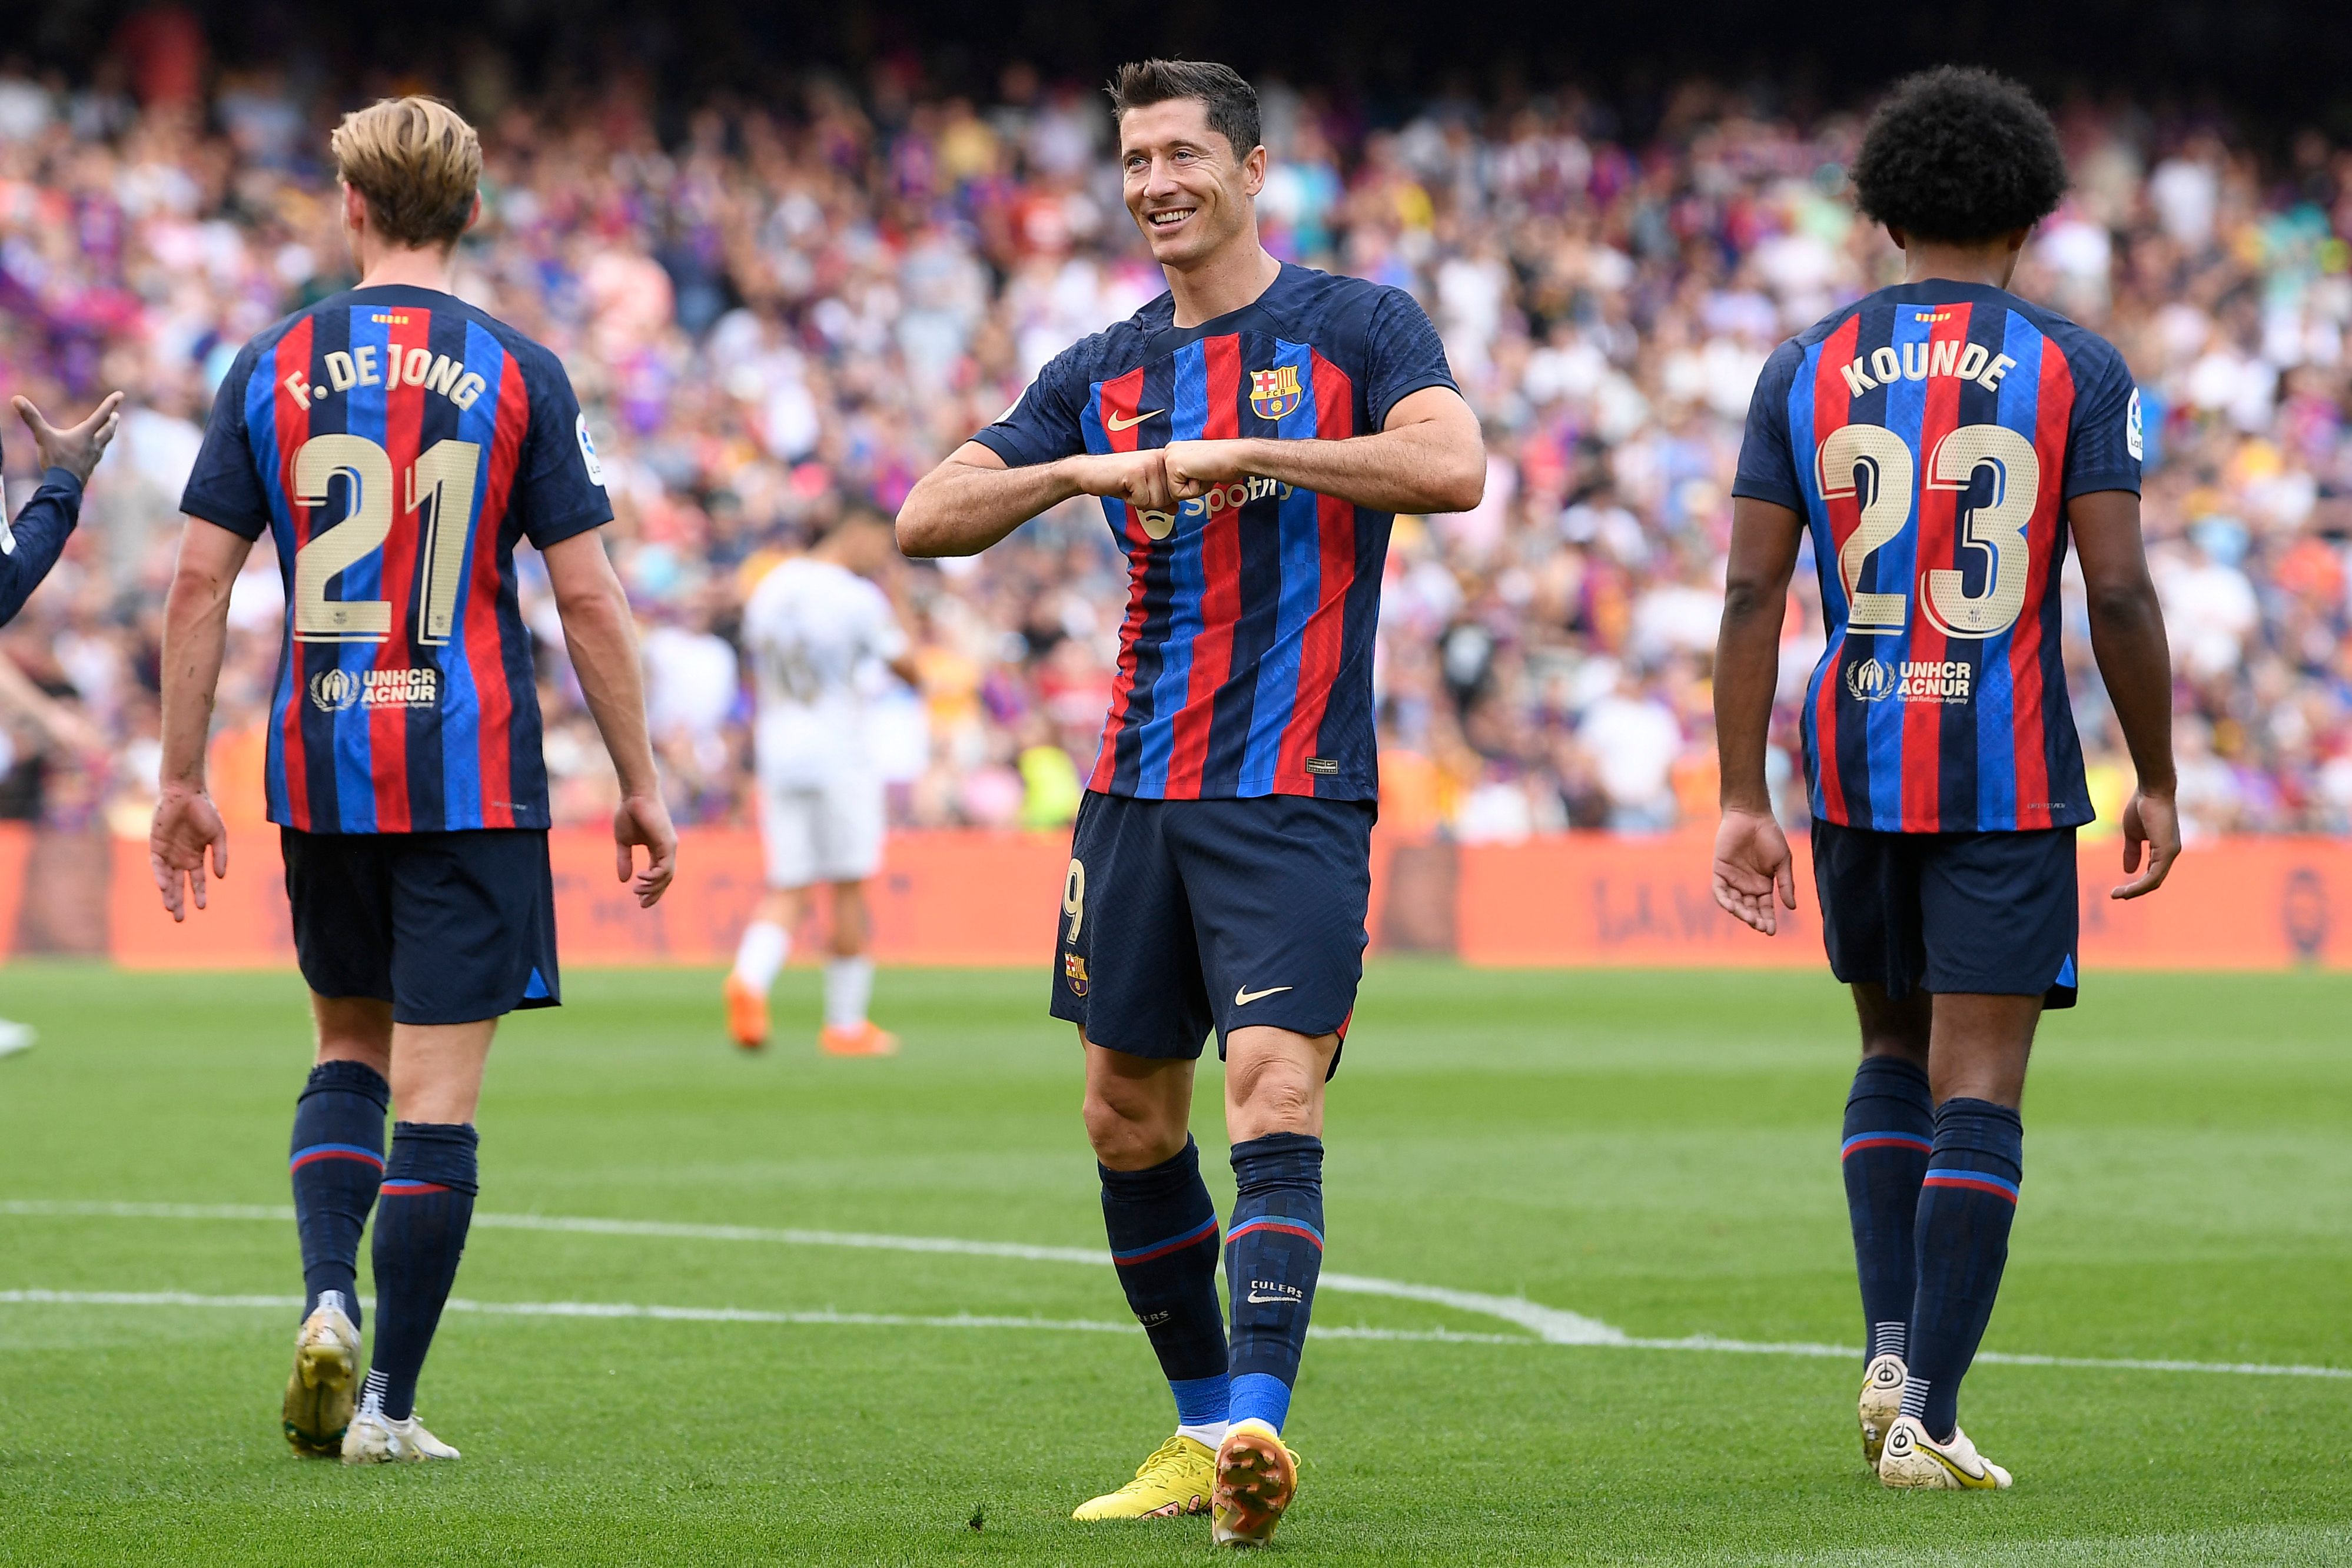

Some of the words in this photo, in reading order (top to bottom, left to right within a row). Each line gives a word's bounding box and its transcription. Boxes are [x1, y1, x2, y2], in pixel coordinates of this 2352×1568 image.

[284, 370, 328, 411] F.
[324, 346, 381, 392] DE
[386, 343, 486, 411] JONG
[1840, 340, 2017, 398] KOUNDE
[1266, 388, 1285, 398] FCB
[290, 433, 480, 646] 21
[1815, 424, 2040, 639] 23
[363, 668, 436, 686] UNHCR
[1899, 661, 1971, 679] UNHCR
[361, 685, 436, 703] ACNUR
[1896, 679, 1969, 696] ACNUR
[1062, 858, 1085, 945] 9
[1251, 1280, 1303, 1298] CULERS
